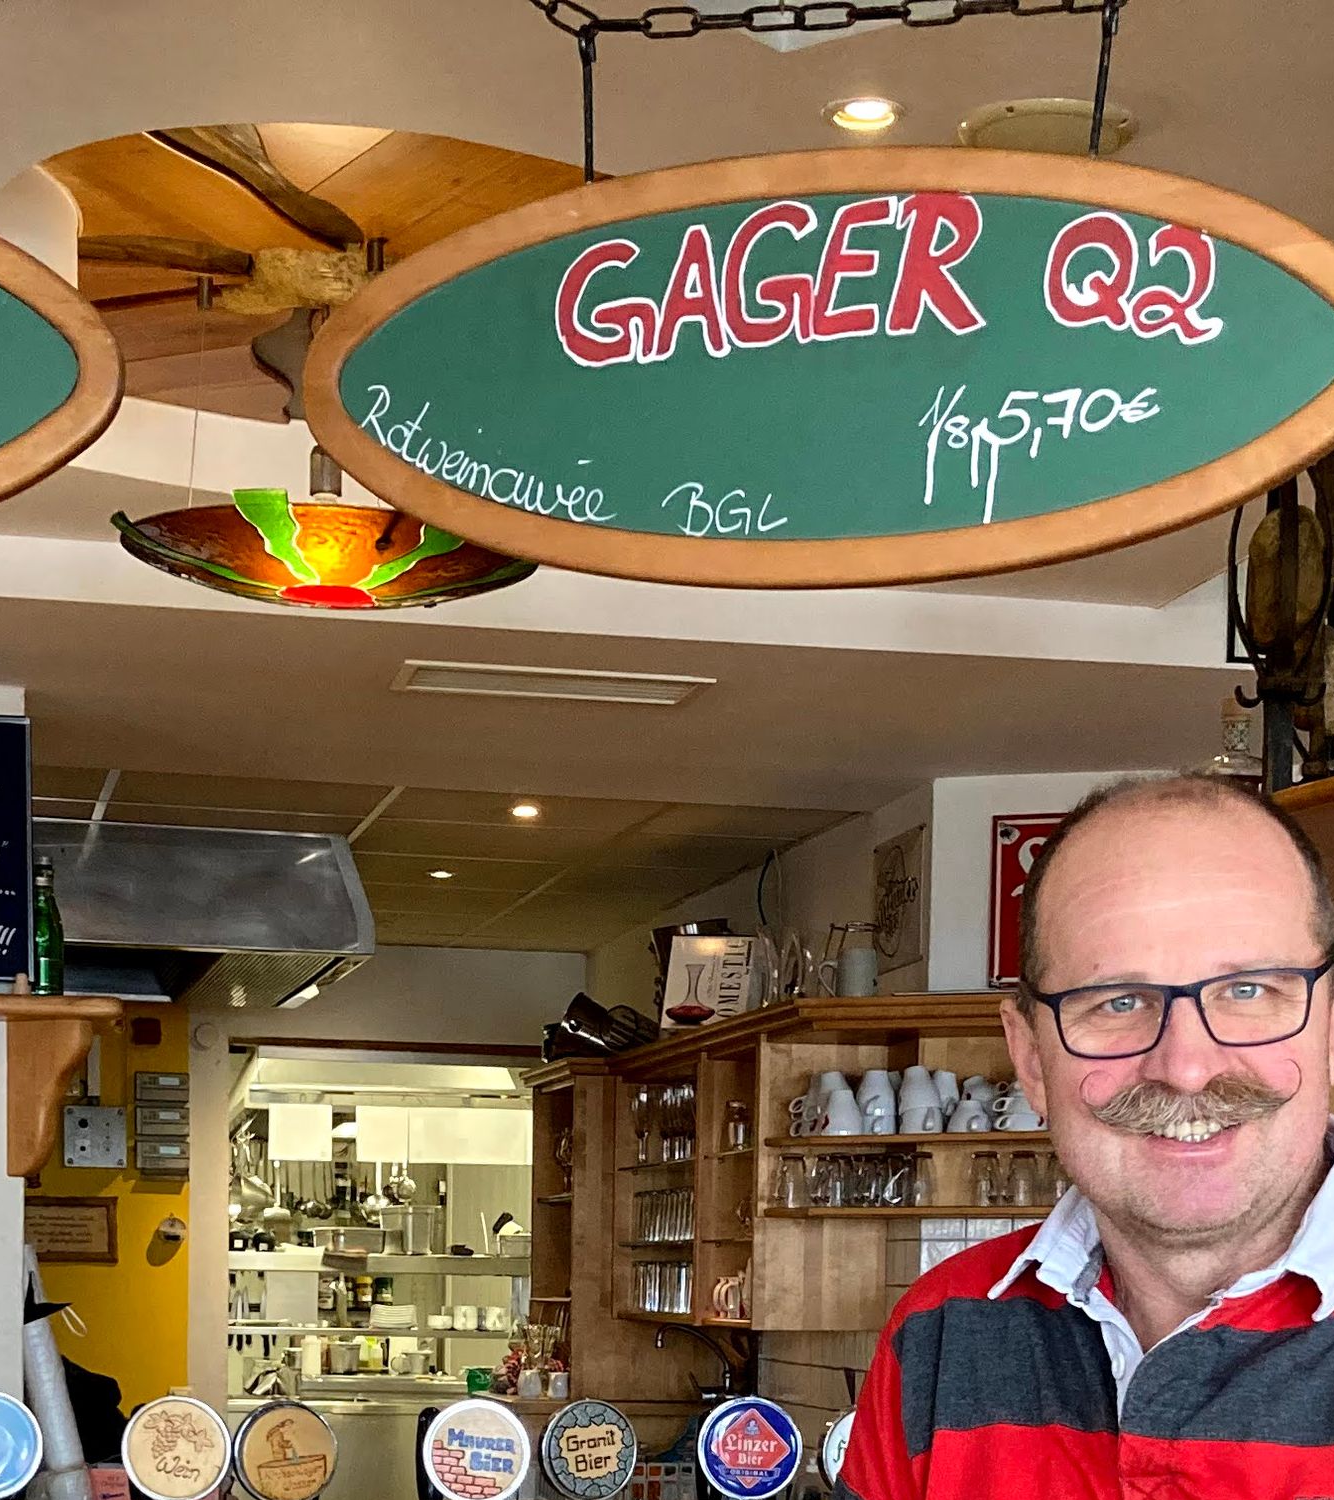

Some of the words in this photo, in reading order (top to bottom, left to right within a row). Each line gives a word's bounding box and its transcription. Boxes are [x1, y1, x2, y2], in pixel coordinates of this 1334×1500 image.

[555, 190, 988, 367] GAGER
[1043, 211, 1224, 346] Q2
[661, 482, 788, 537] BGL
[716, 939, 745, 1018] OMESTIC
[447, 1427, 516, 1454] MAURER
[567, 1430, 616, 1453] Granit
[724, 1433, 778, 1452] Linzer
[155, 1456, 201, 1483] Wein
[575, 1454, 611, 1473] Bier
[737, 1452, 764, 1465] Bier
